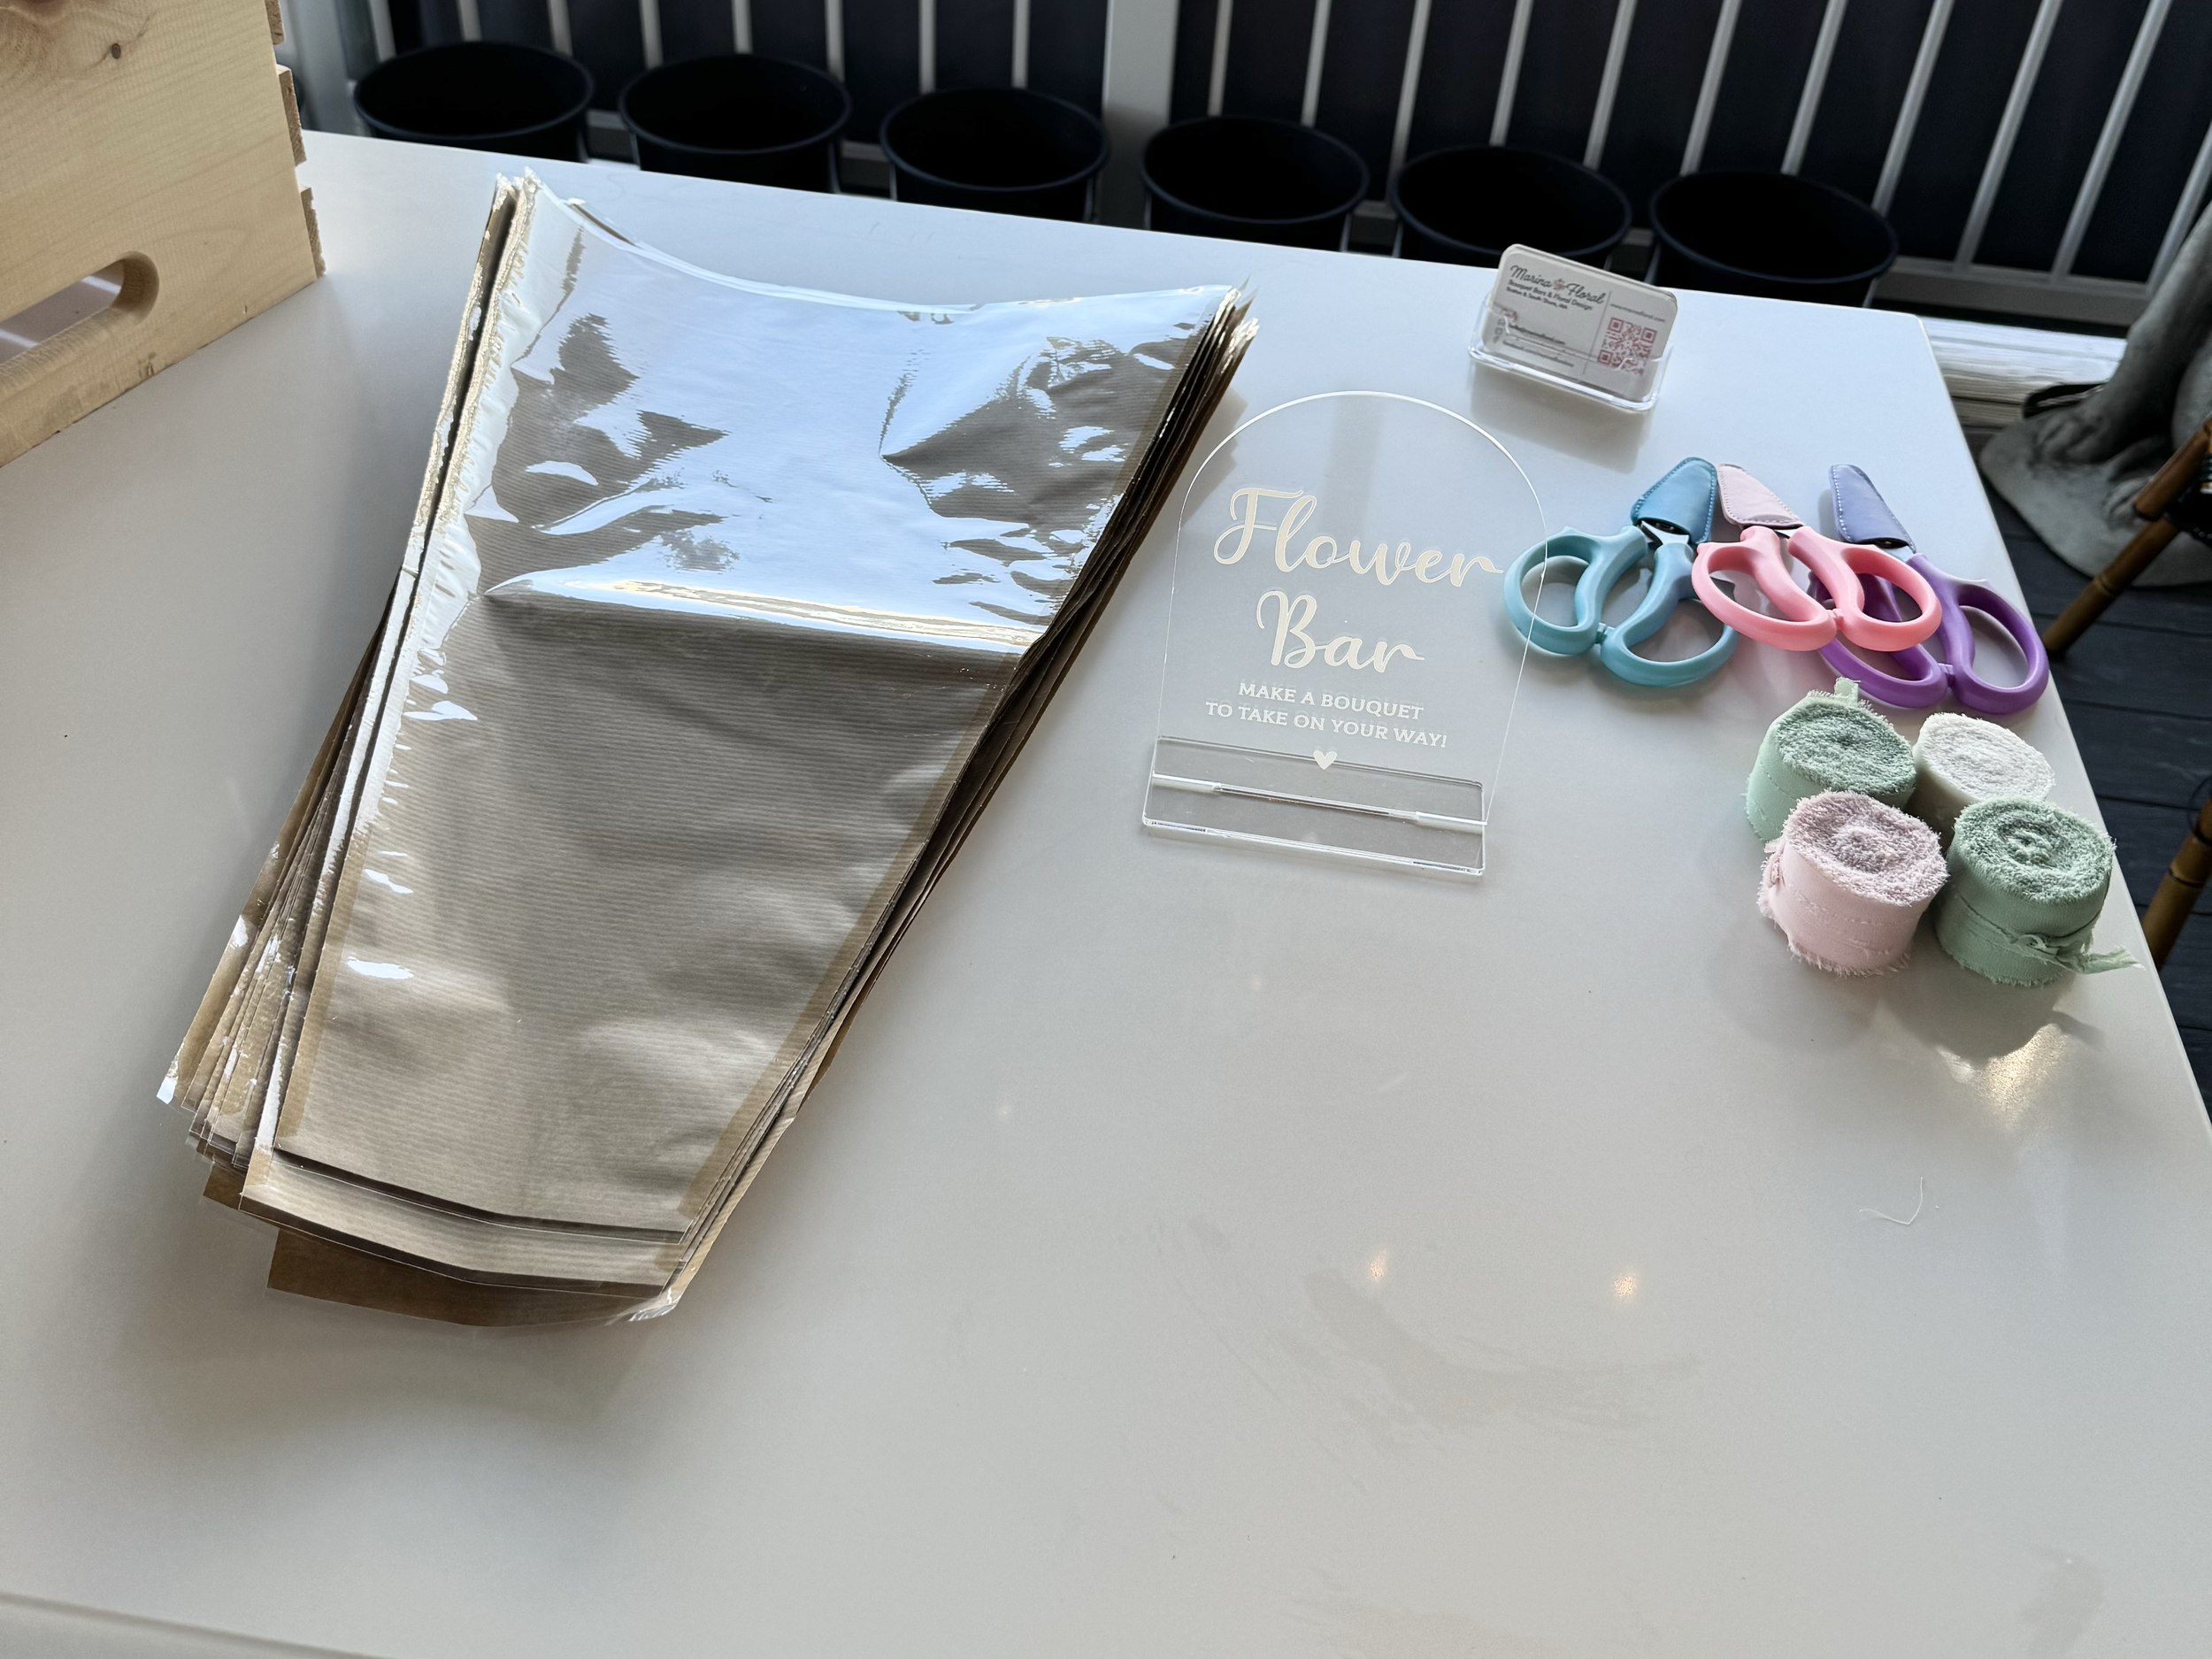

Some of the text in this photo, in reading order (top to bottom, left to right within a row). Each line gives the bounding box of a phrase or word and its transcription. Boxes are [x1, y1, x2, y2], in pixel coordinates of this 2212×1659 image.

[1509, 265, 1606, 304] Marina Floral
[1553, 293, 1571, 303] Floral
[1571, 299, 1593, 311] Design
[1213, 487, 1503, 587] Flower
[1256, 589, 1425, 672] Bar
[1238, 682, 1424, 720] MAKE A BOUQUET
[1206, 701, 1448, 748] TO TAKE ON YOUR WAY!
